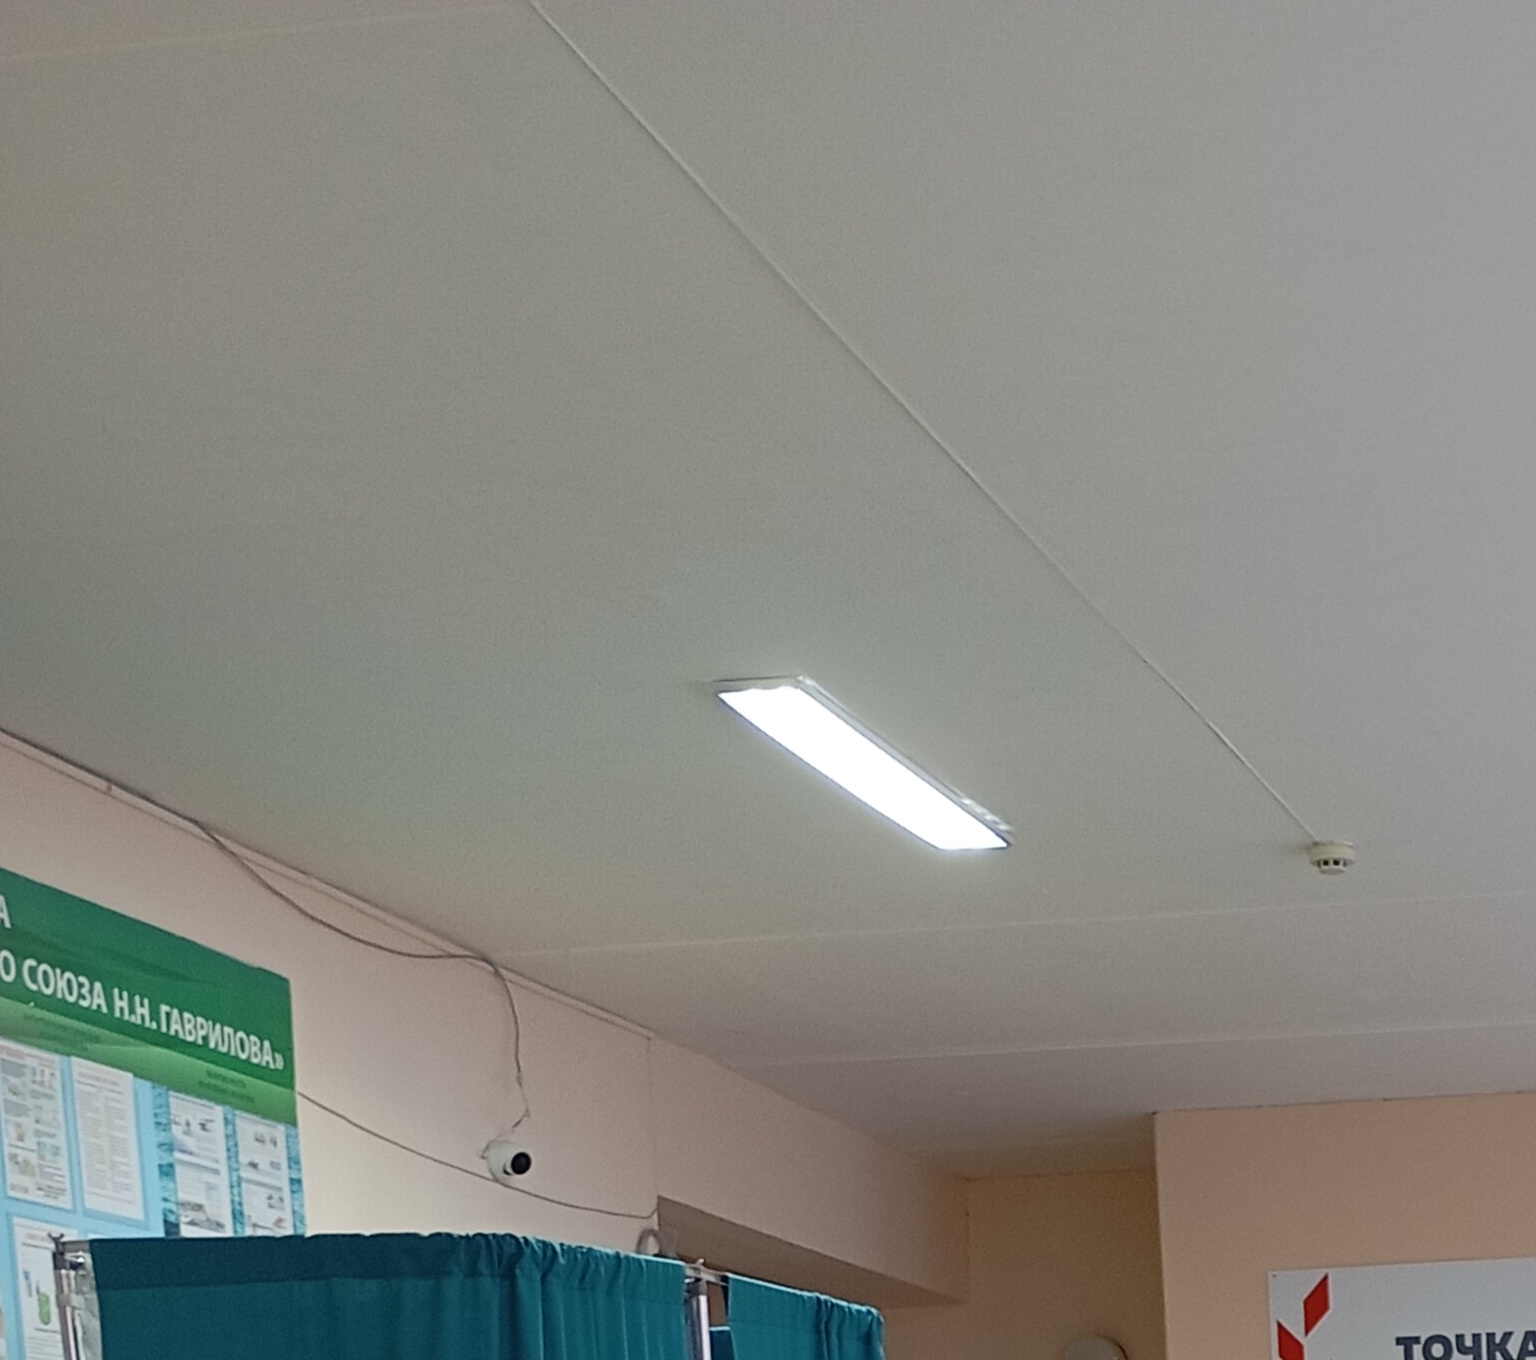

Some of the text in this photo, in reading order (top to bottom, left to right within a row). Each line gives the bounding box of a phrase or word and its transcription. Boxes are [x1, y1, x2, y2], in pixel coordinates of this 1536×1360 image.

[22, 957, 108, 1014] СОЮЗА
[113, 987, 158, 1030] Н.Н.
[159, 1003, 285, 1070] ГАВРИЛОВА»
